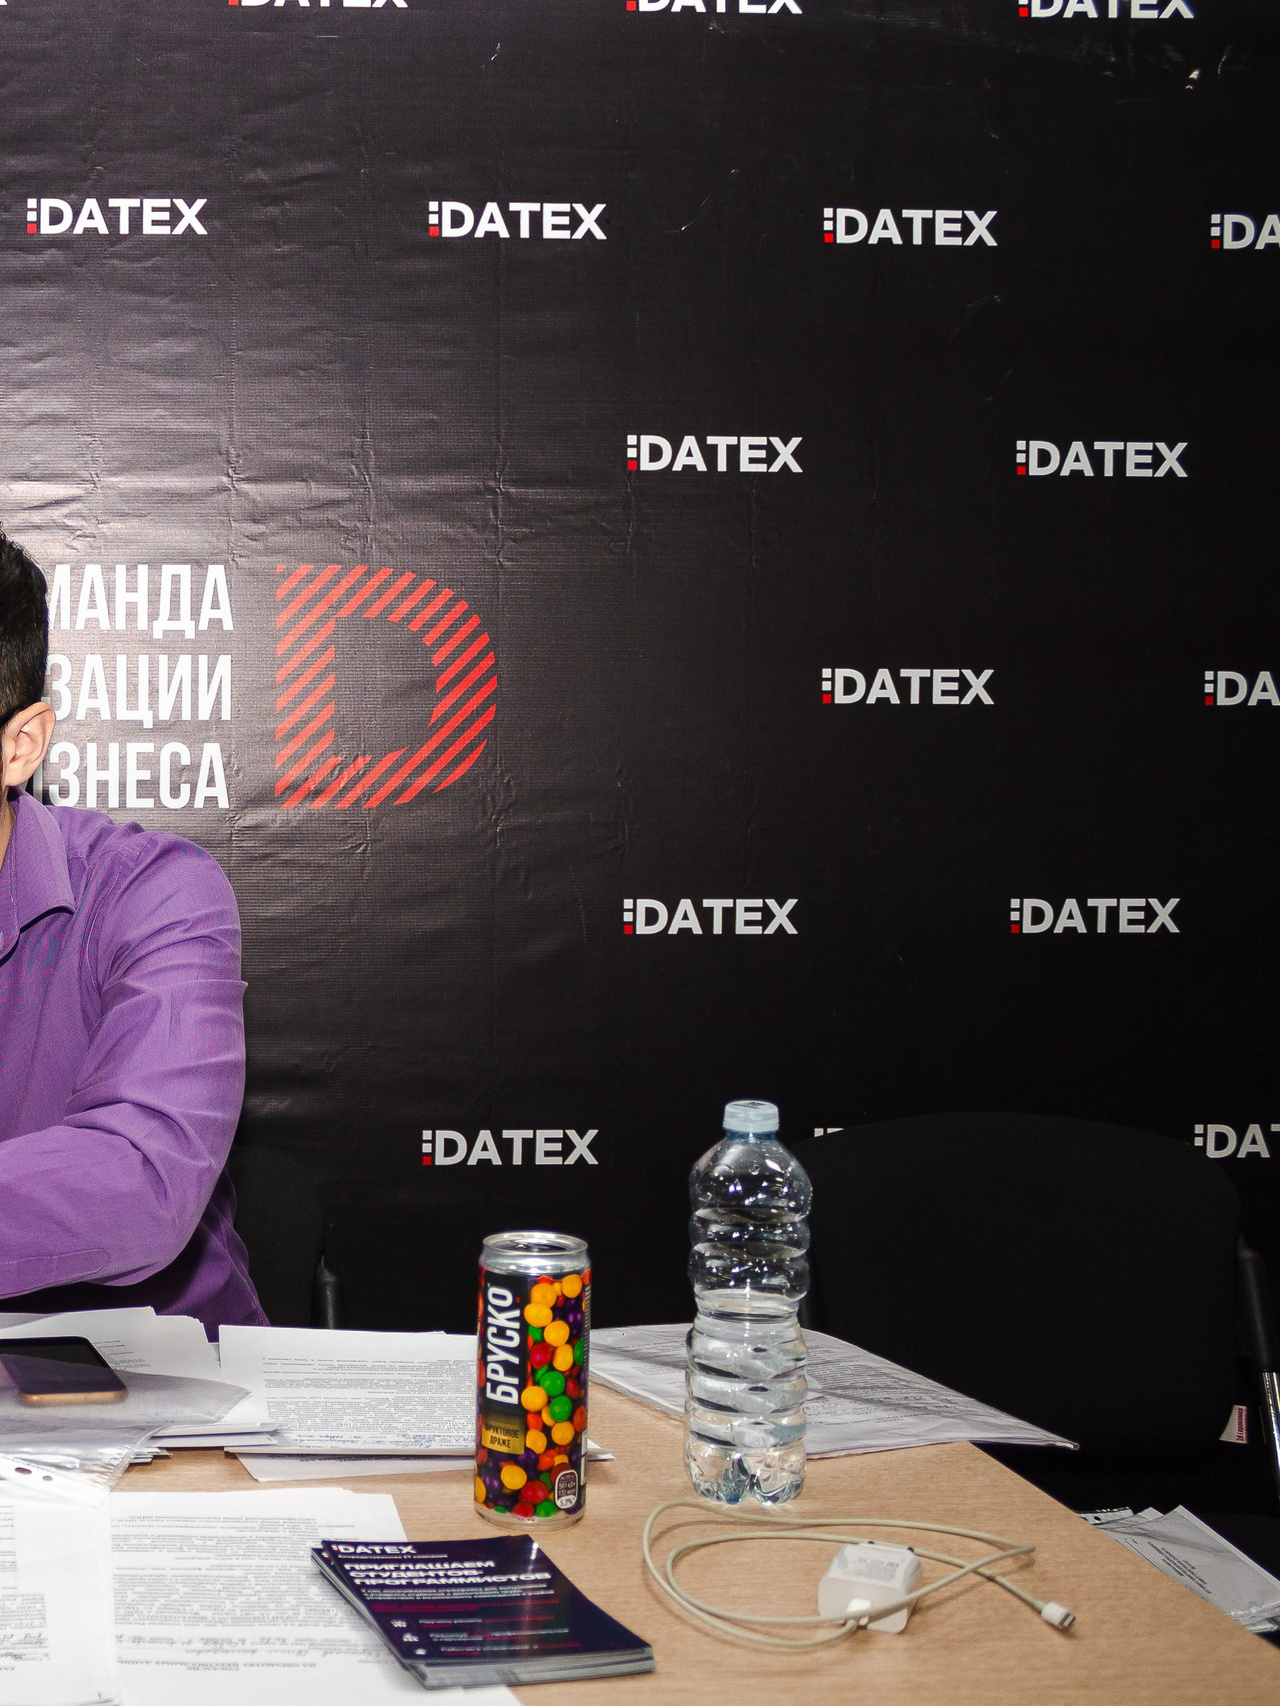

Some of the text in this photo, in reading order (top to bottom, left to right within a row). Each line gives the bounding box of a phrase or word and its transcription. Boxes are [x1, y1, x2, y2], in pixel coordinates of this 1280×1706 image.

[39, 196, 209, 236] DATEX
[441, 200, 608, 240] DATEX
[835, 207, 998, 247] DATEX
[639, 434, 804, 473] DATEX
[1028, 440, 1188, 478] DATEX
[834, 667, 995, 705] DATEX
[635, 898, 799, 935] DATEX
[1022, 898, 1181, 934] DATEX
[434, 1129, 599, 1166] DATEX
[486, 1285, 521, 1405] БРУСКО
[490, 1435, 511, 1449] ДРАЖЕ
[338, 1544, 417, 1554] DATEX
[344, 1560, 495, 1571] ПРИГЛАШАЕМ
[353, 1573, 552, 1586] ПРОГРАММИСТОВ
